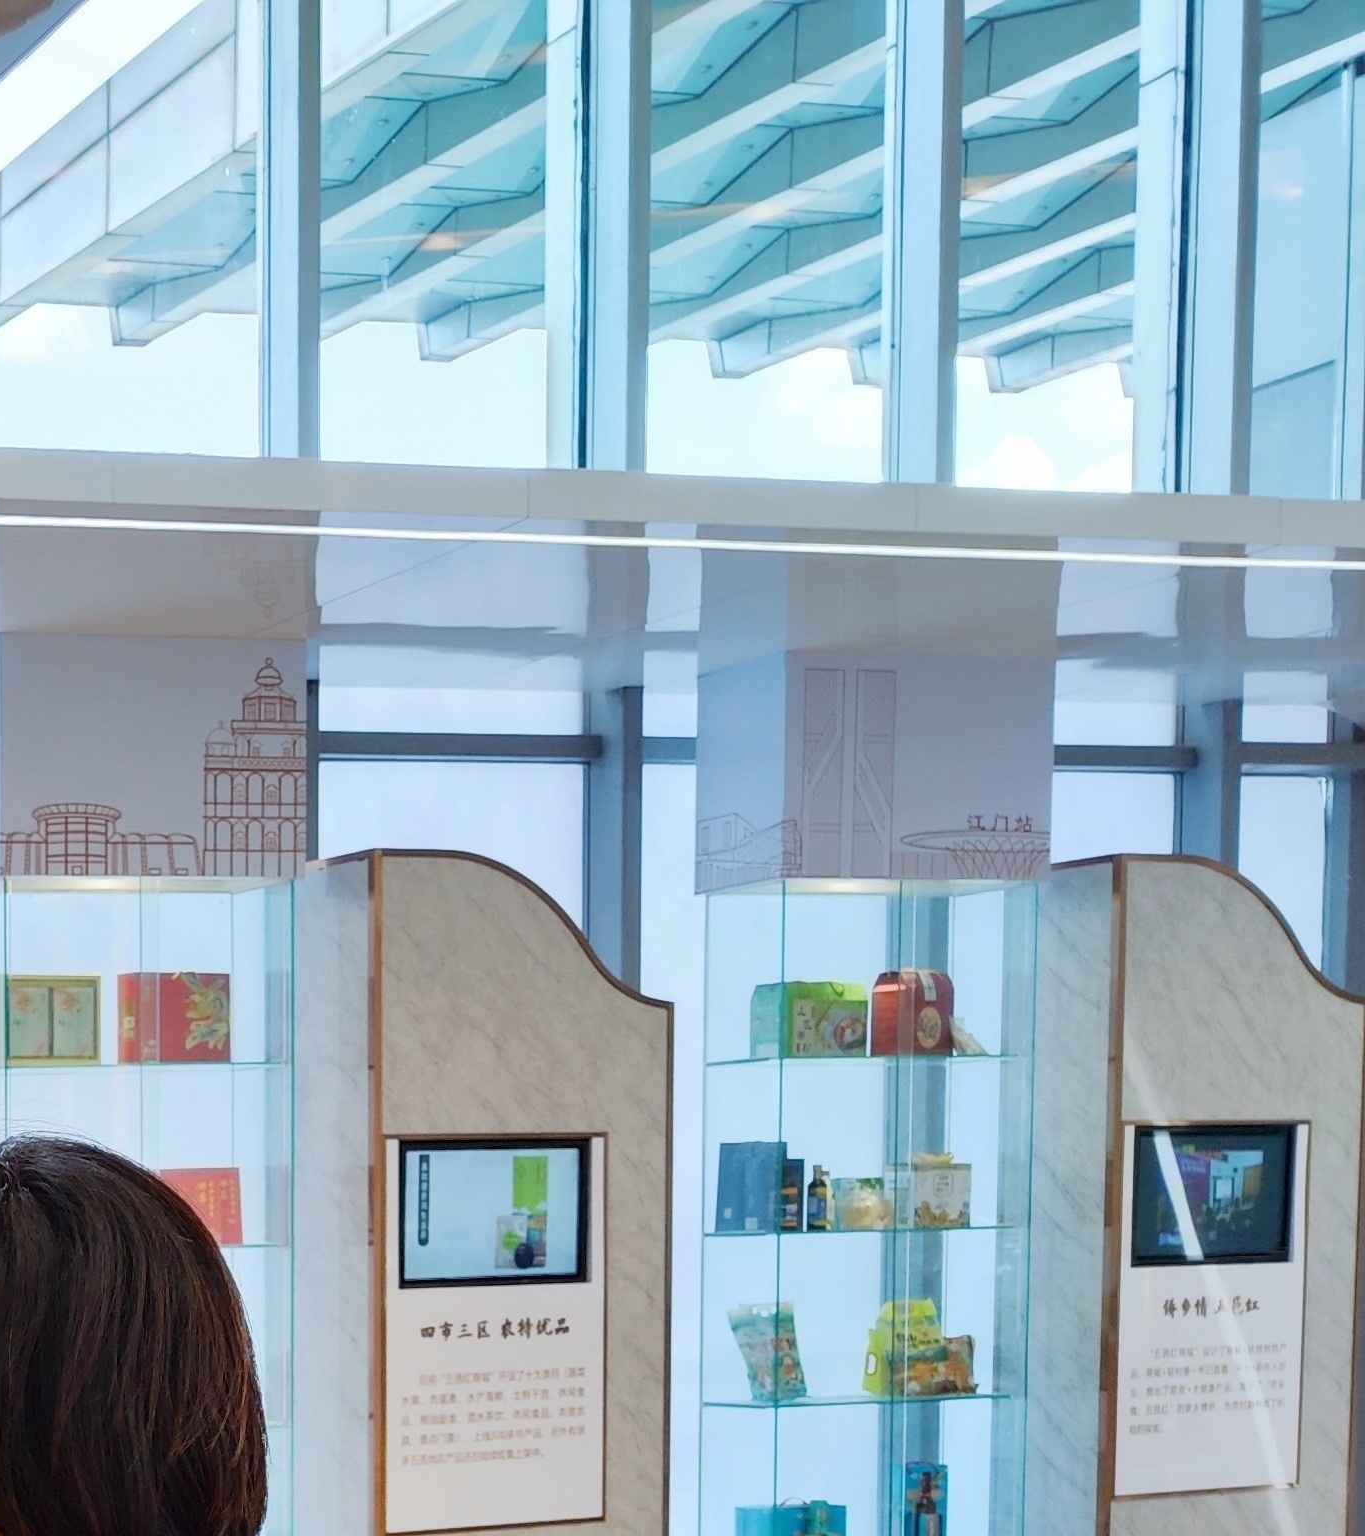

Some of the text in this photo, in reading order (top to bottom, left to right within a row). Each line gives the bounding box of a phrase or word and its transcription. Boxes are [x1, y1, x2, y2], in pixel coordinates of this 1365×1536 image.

[967, 813, 1033, 832] 江门站
[421, 1317, 570, 1341] 四市三区 农特优品
